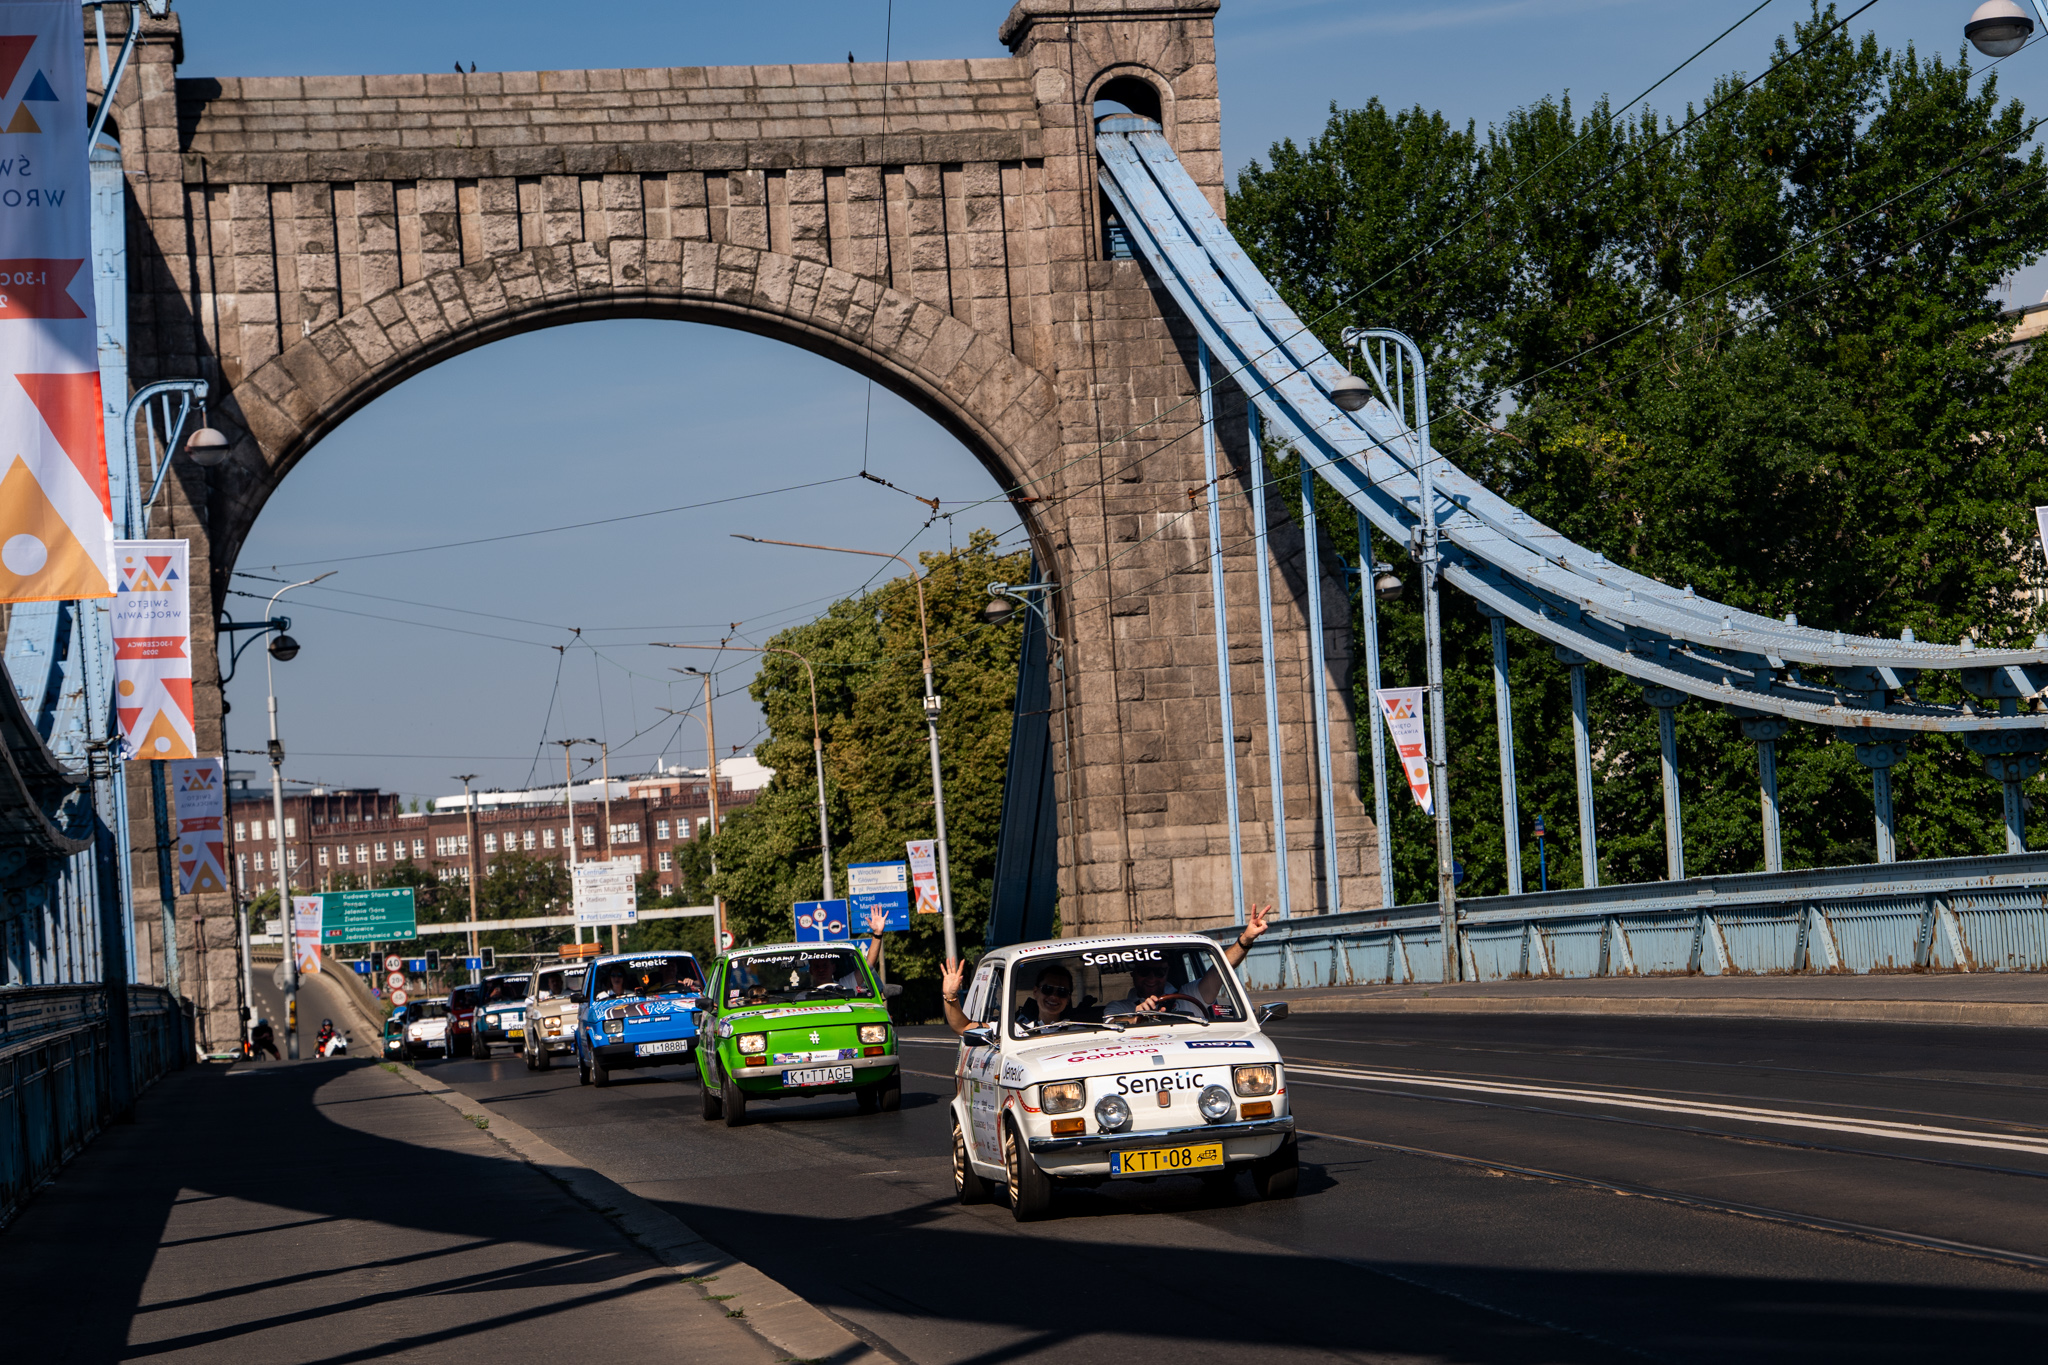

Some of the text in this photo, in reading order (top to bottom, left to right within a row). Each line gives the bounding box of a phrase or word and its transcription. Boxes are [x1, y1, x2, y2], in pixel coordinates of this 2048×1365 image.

[387, 959, 400, 968] 40
[629, 958, 668, 969] Senetic
[746, 955, 795, 966] Pomagamy
[800, 952, 840, 961] Dzieciom
[1082, 948, 1162, 966] Senetic
[660, 1041, 687, 1052] 1888H
[1191, 1040, 1248, 1049] moya
[1067, 1048, 1159, 1063] Gabona
[790, 1066, 851, 1084] K1 TTAGE
[1003, 1061, 1025, 1082] Senetic
[1116, 1071, 1205, 1096] Senetic
[1124, 1148, 1192, 1172] KTT 08
